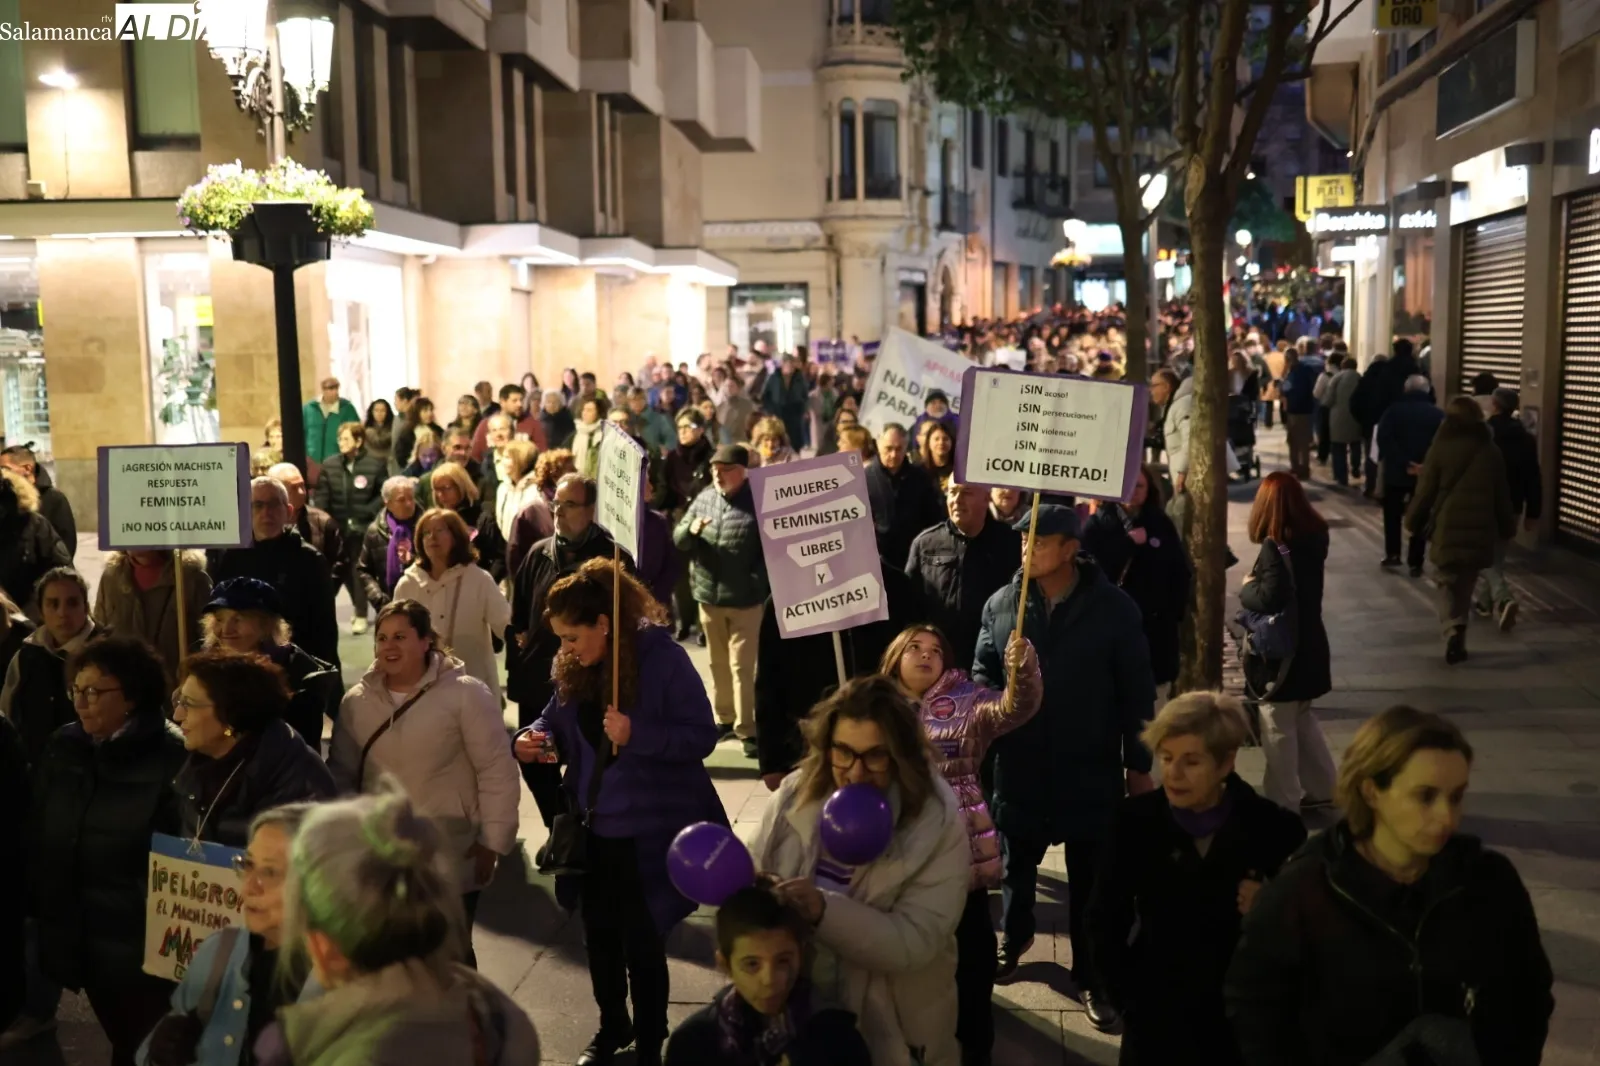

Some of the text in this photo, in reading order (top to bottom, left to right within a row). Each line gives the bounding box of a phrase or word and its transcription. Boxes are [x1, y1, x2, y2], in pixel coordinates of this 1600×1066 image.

[1020, 384, 1068, 399] ¡SIN acoso!
[1018, 403, 1097, 421] ¡SIN persecuciones!
[1016, 422, 1076, 438] ¡SIN violencia!
[1014, 440, 1078, 456] ¡SIN amenazas!
[122, 460, 223, 473] ¡AGRESIÓN MACHISTA
[986, 458, 1108, 482] ¡CON LIBERTAD!
[148, 478, 198, 488] RESPUESTA
[774, 478, 839, 501] ¡MUJERES
[140, 496, 206, 508] FEMINISTA!
[122, 518, 226, 533] ¡NO NOS CALLARÁN!
[772, 507, 859, 530] FEMINISTAS
[800, 539, 842, 557] LIBRES
[817, 573, 826, 584] Y
[785, 586, 868, 619] ACTIVISTAS!
[156, 898, 168, 915] EL
